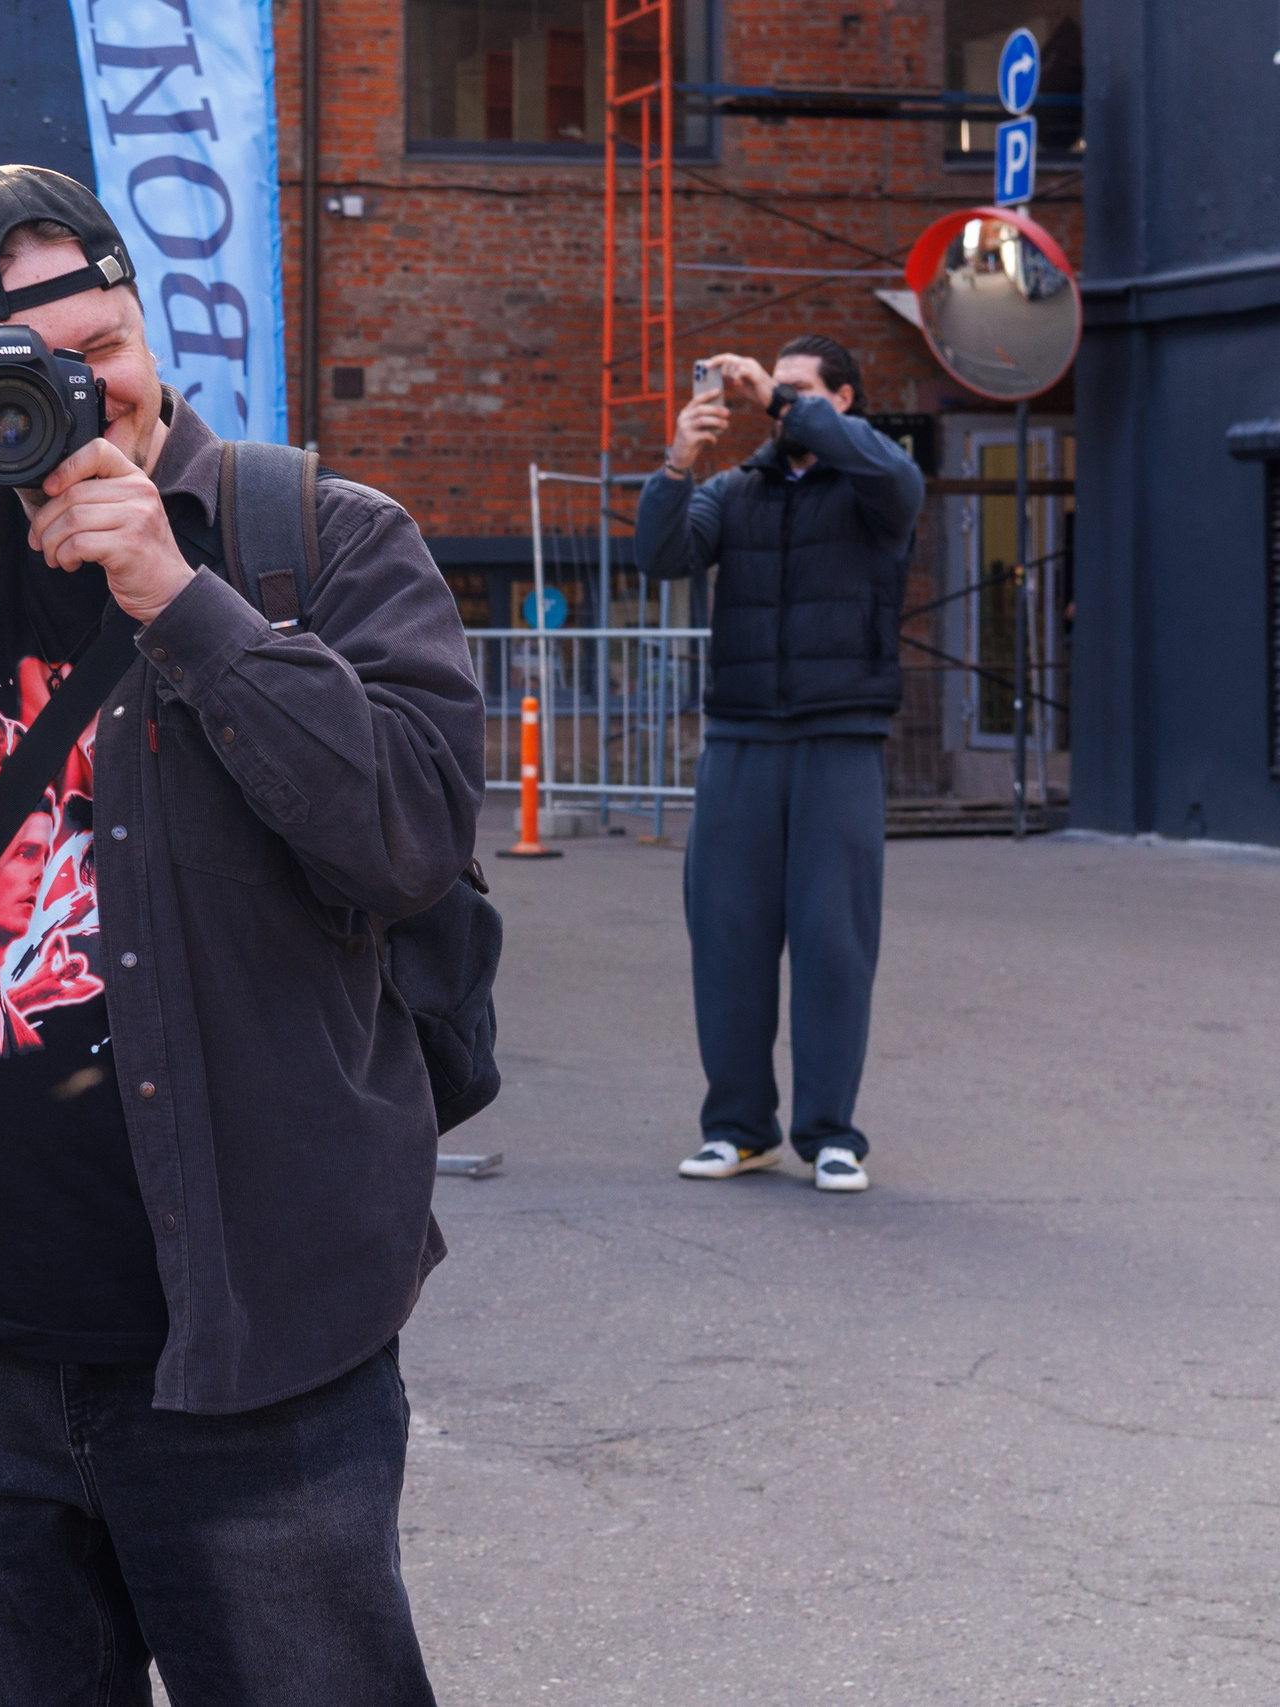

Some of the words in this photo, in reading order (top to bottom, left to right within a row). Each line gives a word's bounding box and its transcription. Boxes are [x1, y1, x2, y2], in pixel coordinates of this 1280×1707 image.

[1005, 129, 1028, 195] P
[68, 376, 87, 384] EOS
[73, 391, 87, 400] 5D
